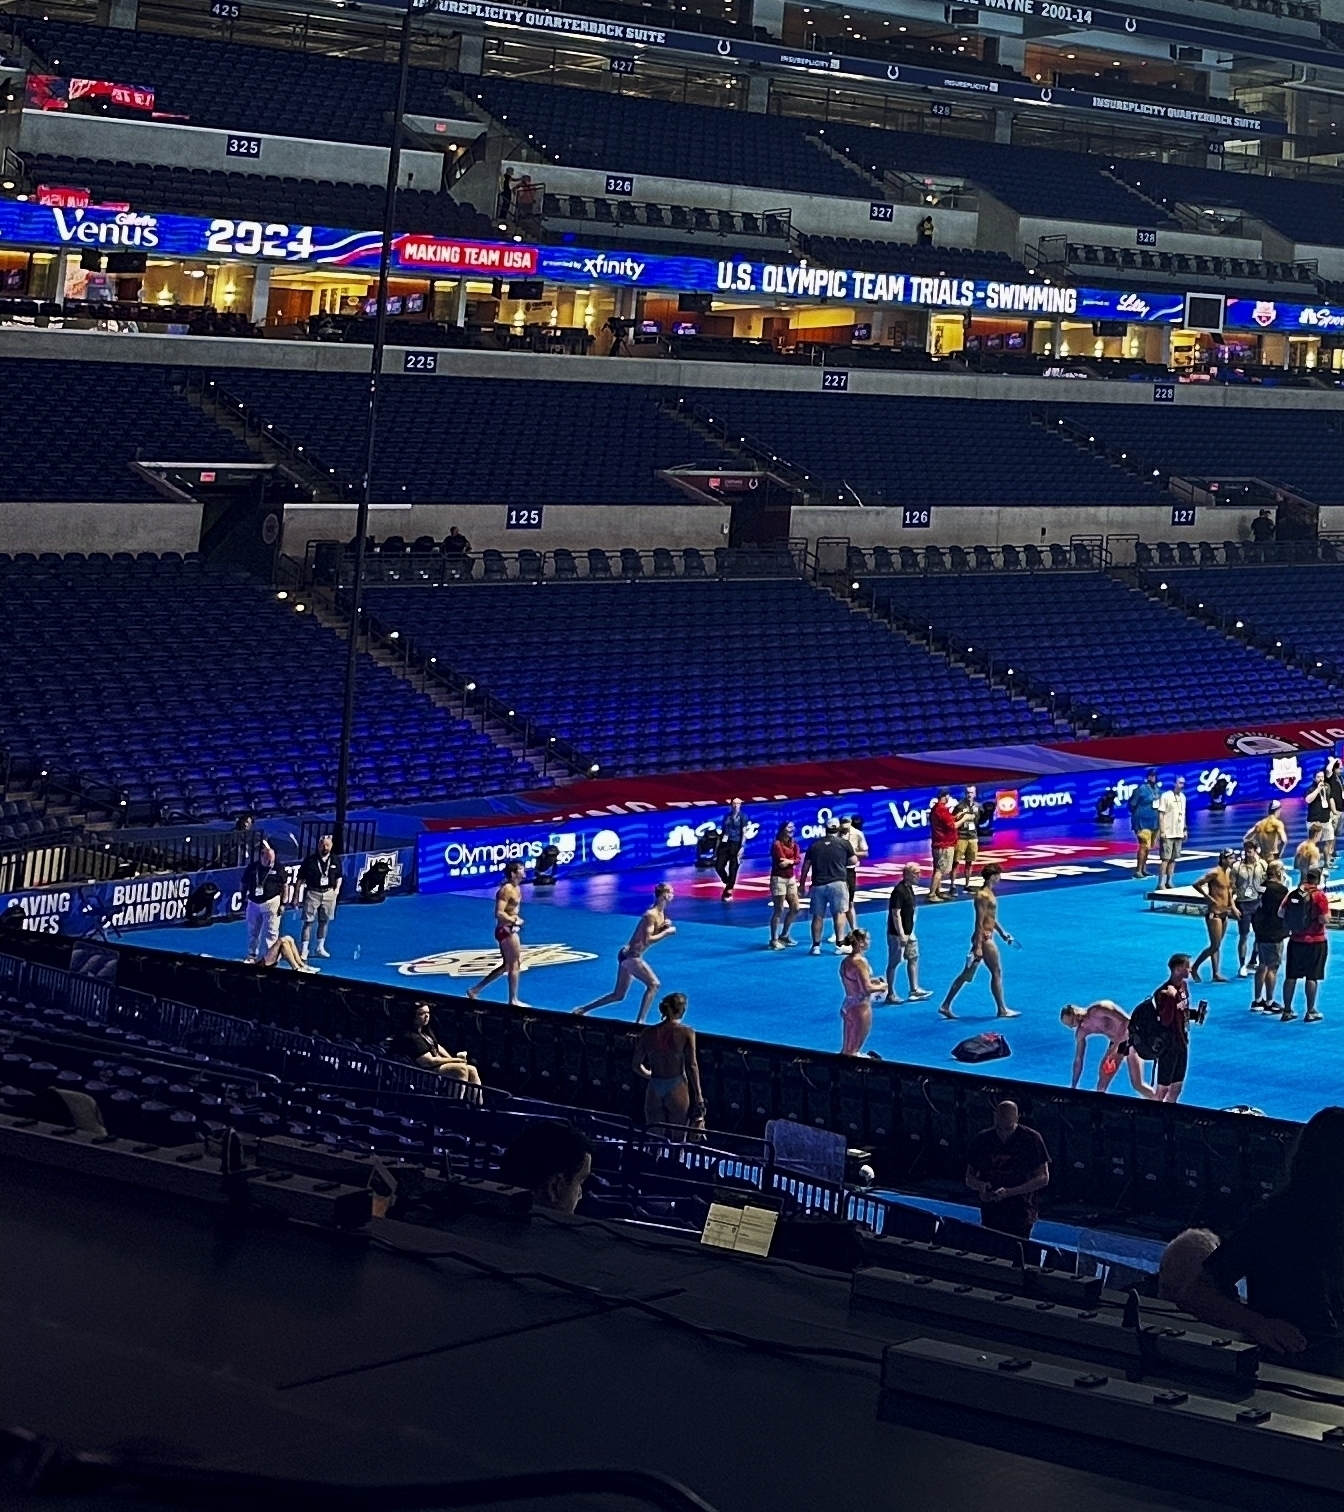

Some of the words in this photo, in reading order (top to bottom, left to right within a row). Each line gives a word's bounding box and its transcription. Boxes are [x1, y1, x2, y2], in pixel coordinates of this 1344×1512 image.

[212, 2, 239, 18] 425
[1041, 2, 1093, 25] 2001-14
[524, 11, 624, 38] QUARTERBACK
[625, 28, 666, 45] SUITE
[610, 59, 634, 73] 427
[1233, 116, 1261, 130] SUITE
[229, 139, 259, 155] 325
[606, 179, 632, 193] 326
[871, 206, 892, 220] 327
[51, 207, 160, 249] Venus
[206, 219, 316, 259] 2024
[404, 242, 461, 265] MAKING
[463, 247, 500, 267] TEAM
[503, 250, 532, 269] USA
[582, 254, 646, 281] xfinity
[716, 260, 756, 291] U.S.
[762, 265, 847, 298] OLYMPIC
[853, 271, 904, 303] TEAM
[1116, 293, 1150, 316] Lilly
[406, 355, 436, 370] 225
[824, 374, 847, 387] 227
[1155, 387, 1174, 400] 228
[509, 509, 540, 525] 125
[904, 510, 929, 525] 126
[1173, 510, 1194, 523] 127
[1021, 791, 1073, 809] TOYOTA
[444, 838, 543, 868] Olympians
[112, 878, 191, 907] BUILDING
